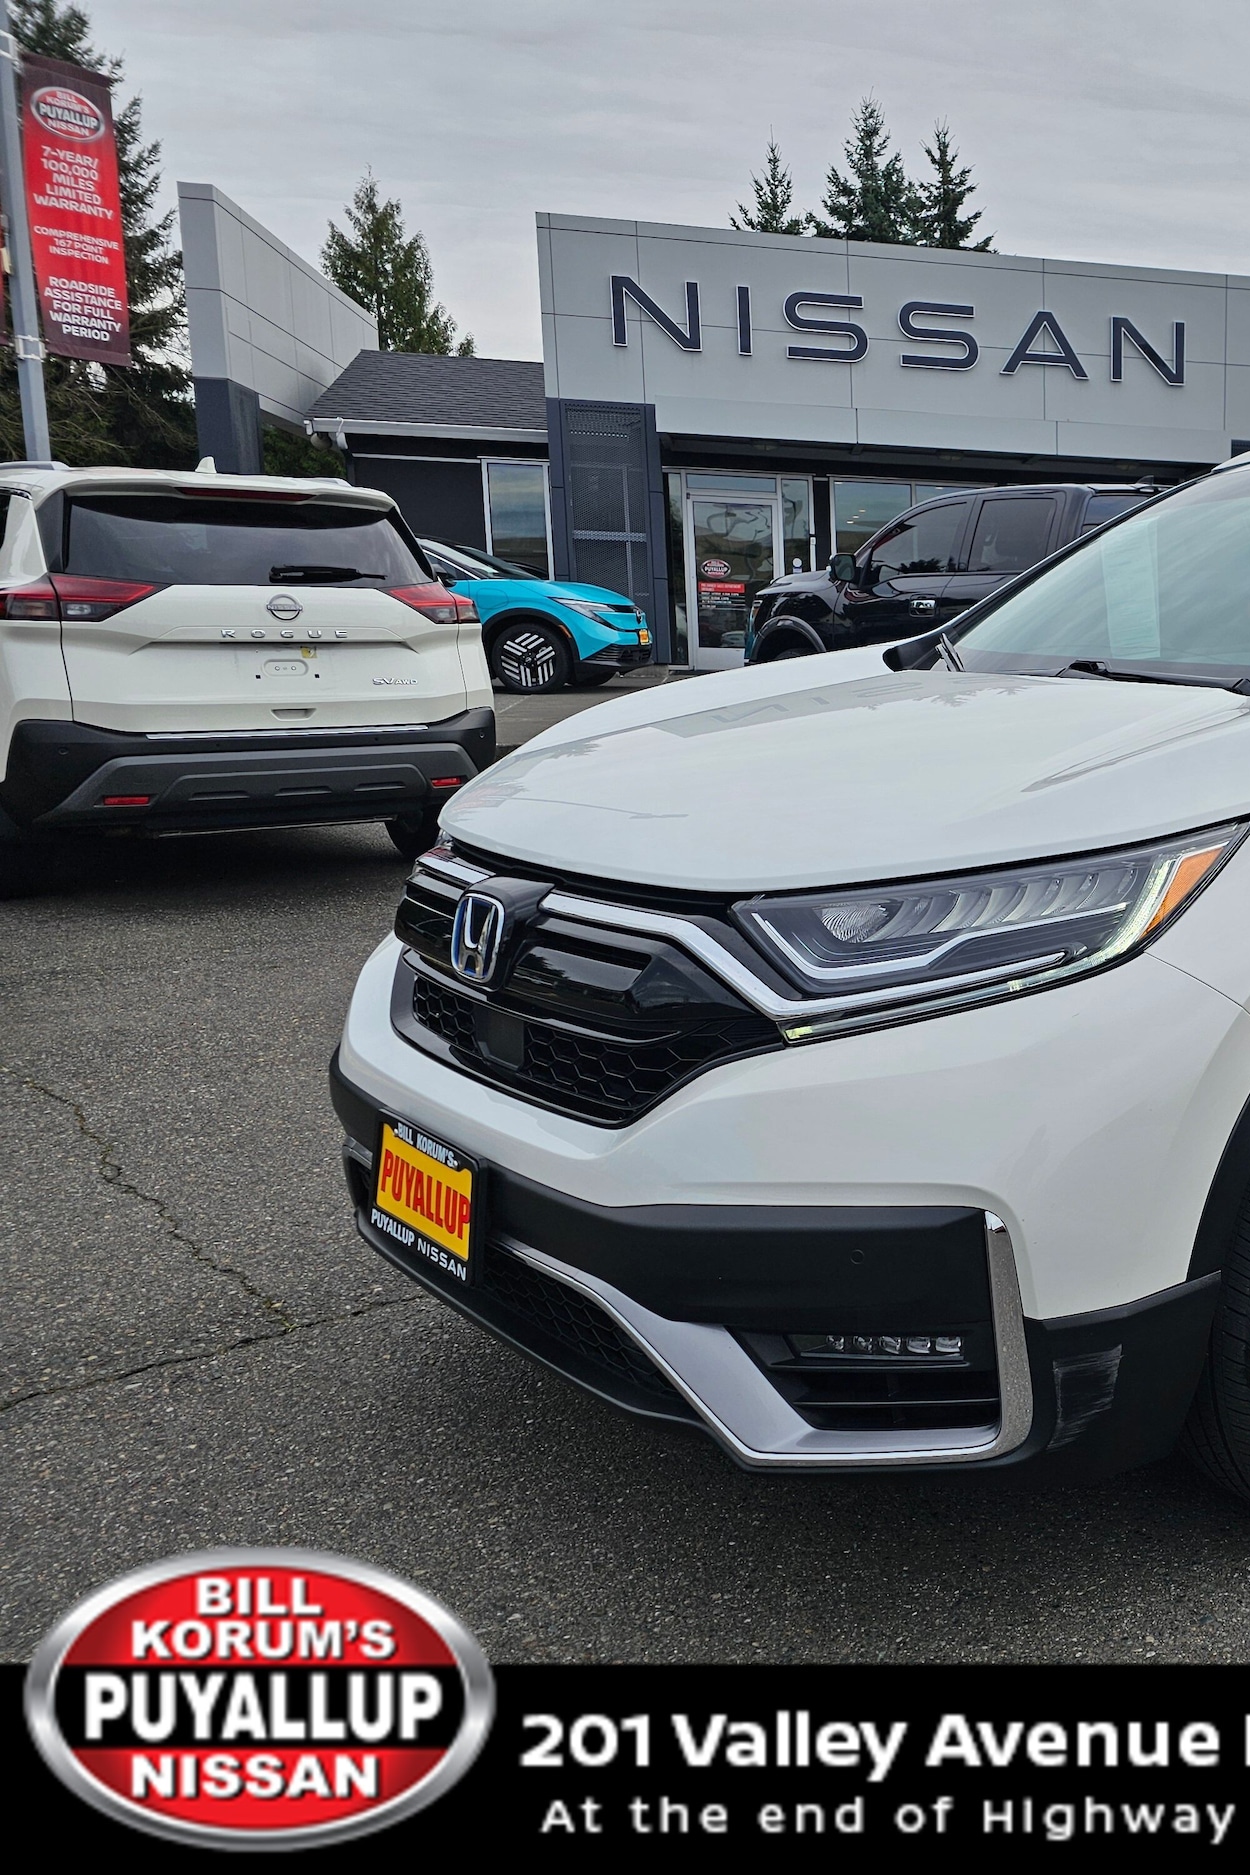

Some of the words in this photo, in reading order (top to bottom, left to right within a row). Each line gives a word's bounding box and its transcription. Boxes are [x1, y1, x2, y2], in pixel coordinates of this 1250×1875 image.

[56, 91, 78, 103] BILL
[39, 101, 99, 129] PUYALLUP
[47, 119, 89, 137] NISSAN
[41, 145, 99, 170] 7-YEAR/
[41, 158, 99, 181] 100,000
[52, 173, 95, 192] MILES
[46, 183, 102, 206] LIMITED
[33, 193, 114, 220] WARRANTY
[33, 225, 119, 250] COMPREHENSIVE
[53, 237, 73, 248] 167
[74, 242, 105, 255] POINT
[49, 245, 109, 265] INSPECTION
[48, 276, 116, 298] ROADSIDE
[44, 287, 123, 311] ASSISTANCE
[52, 300, 82, 314] FOR
[83, 305, 114, 320] FULL
[49, 310, 121, 333] WARRANTY
[62, 324, 110, 342] PERIOD
[609, 274, 1186, 387] NISSAN
[267, 603, 302, 611] NISSAN
[221, 629, 348, 639] ROGUE
[396, 1122, 414, 1146] BILL
[416, 1132, 455, 1168] KORUM'S
[380, 1148, 471, 1241] PUYALLUP
[371, 1207, 415, 1247] PUYALLUP
[417, 1237, 467, 1282] NISSAN
